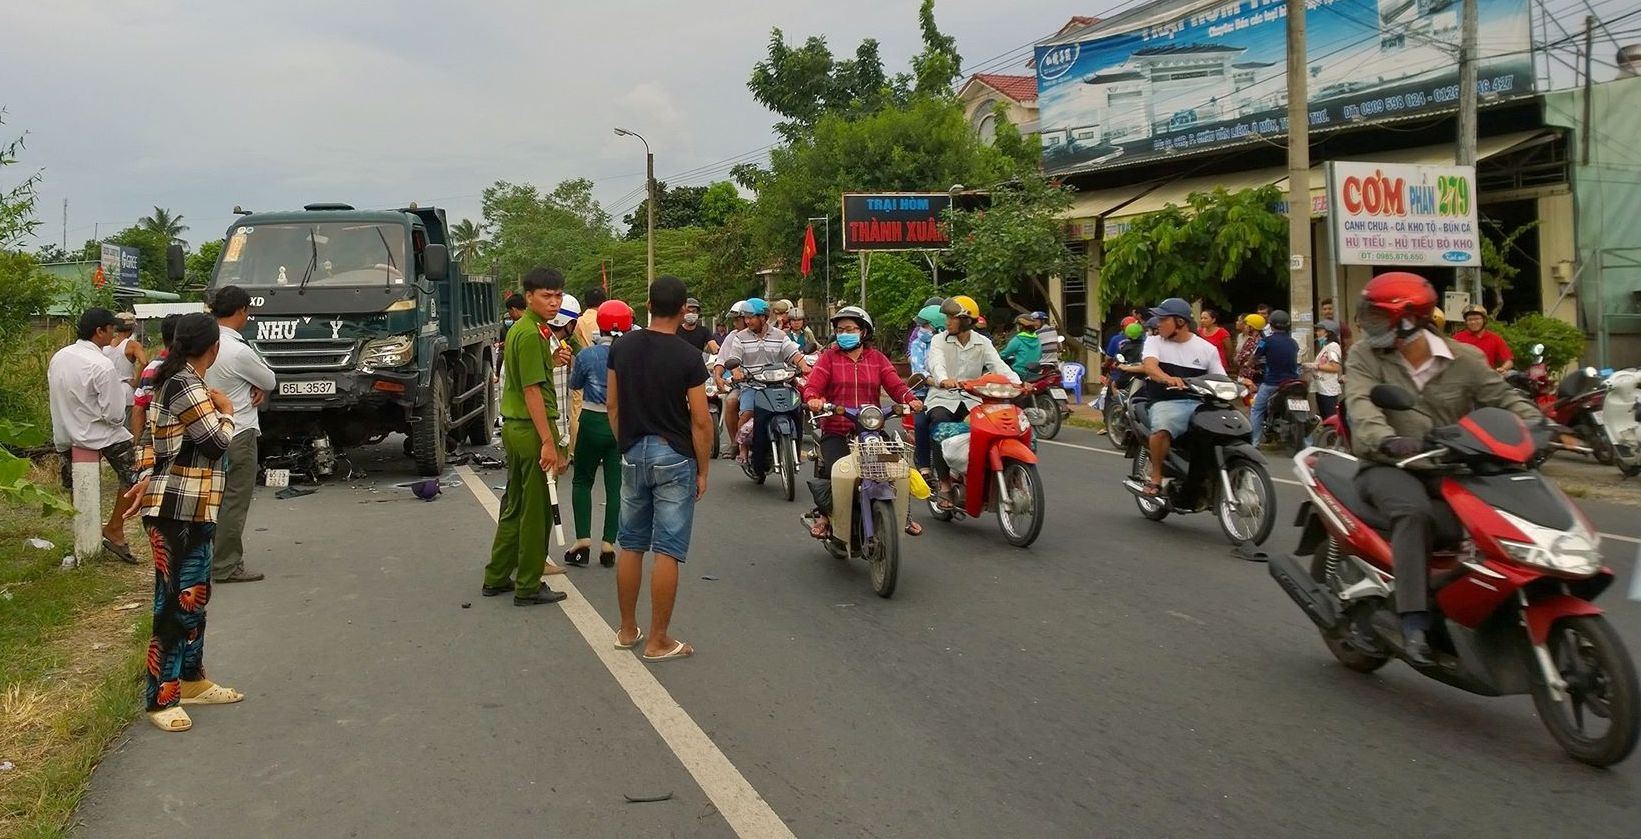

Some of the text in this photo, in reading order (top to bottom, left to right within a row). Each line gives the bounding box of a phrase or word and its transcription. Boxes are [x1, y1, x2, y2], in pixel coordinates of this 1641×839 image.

[1360, 100, 1384, 116] 0909
[1404, 91, 1426, 108] 024
[1491, 74, 1514, 91] 427
[1343, 169, 1407, 217] CƠM
[1437, 175, 1471, 217] 279
[866, 196, 929, 212] TRẠI HÒM
[849, 216, 902, 242] THÀNH
[1344, 220, 1365, 231] CANH
[1367, 220, 1389, 231] CHUA
[1408, 221, 1424, 232] KHO
[1453, 239, 1473, 249] KHO
[282, 382, 333, 394] 65L-3537
